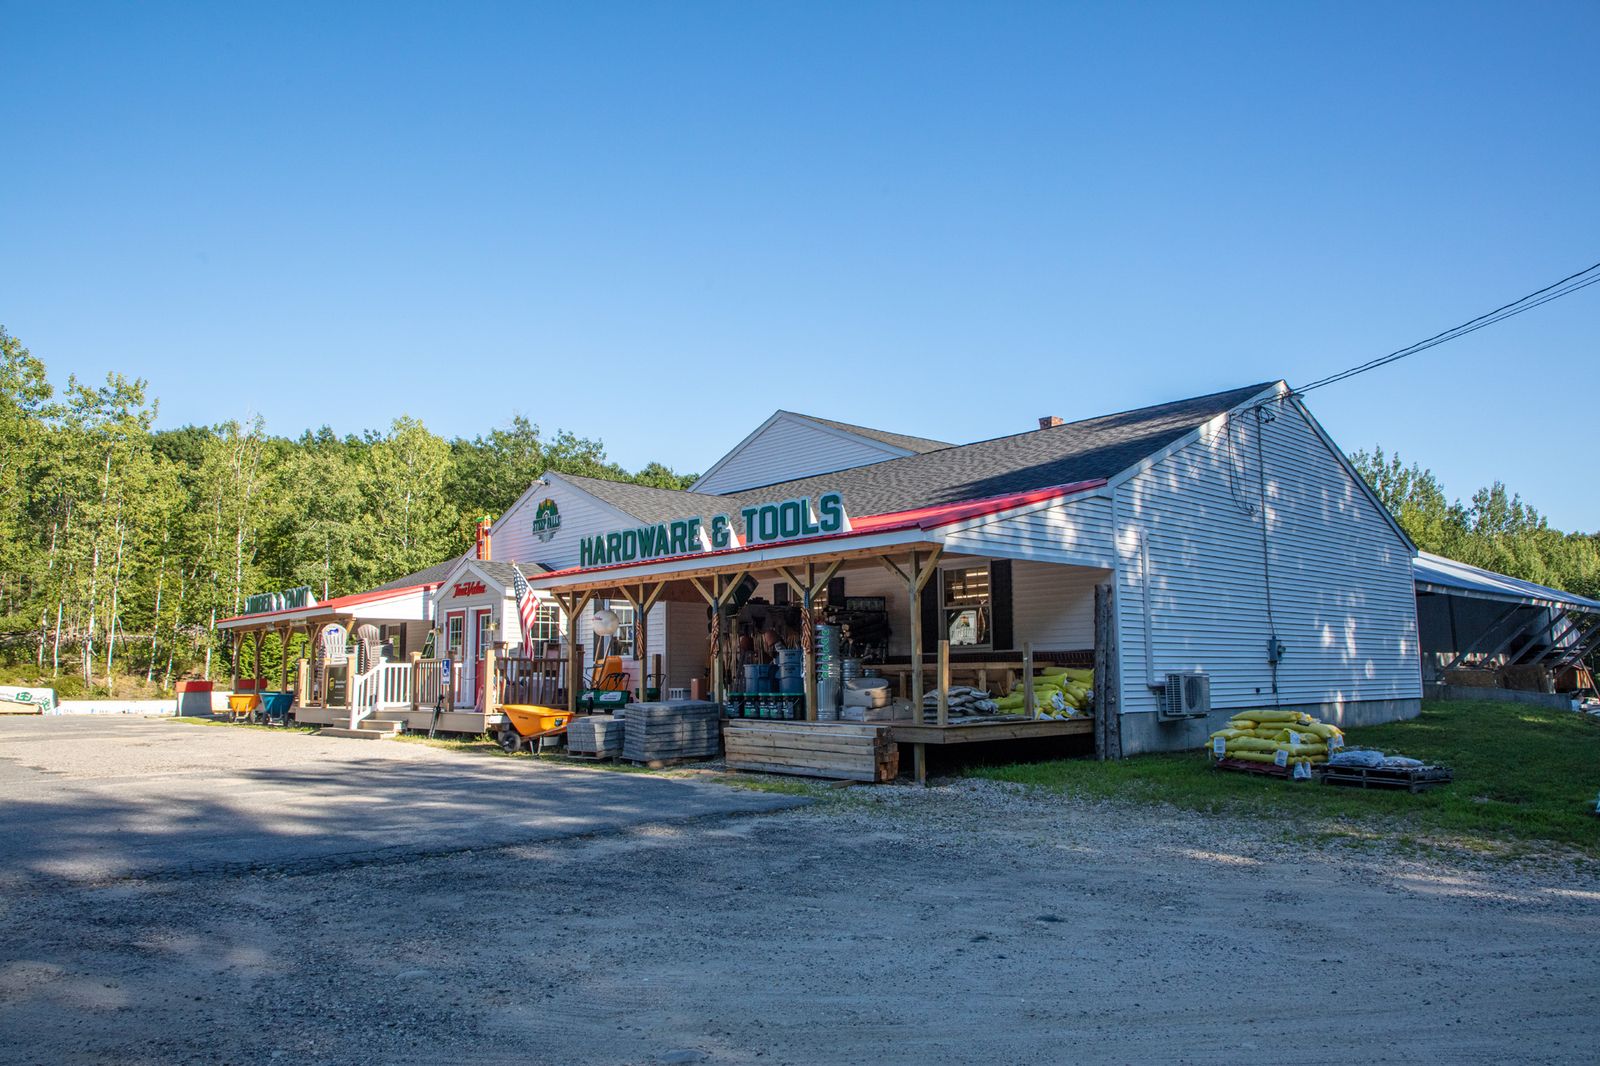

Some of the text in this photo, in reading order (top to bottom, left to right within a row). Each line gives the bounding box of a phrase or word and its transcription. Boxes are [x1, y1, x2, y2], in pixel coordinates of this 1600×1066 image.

[579, 494, 841, 567] HARDWARE & TOOLS
[244, 593, 273, 615] LUMBER
[285, 586, 310, 610] PAINT
